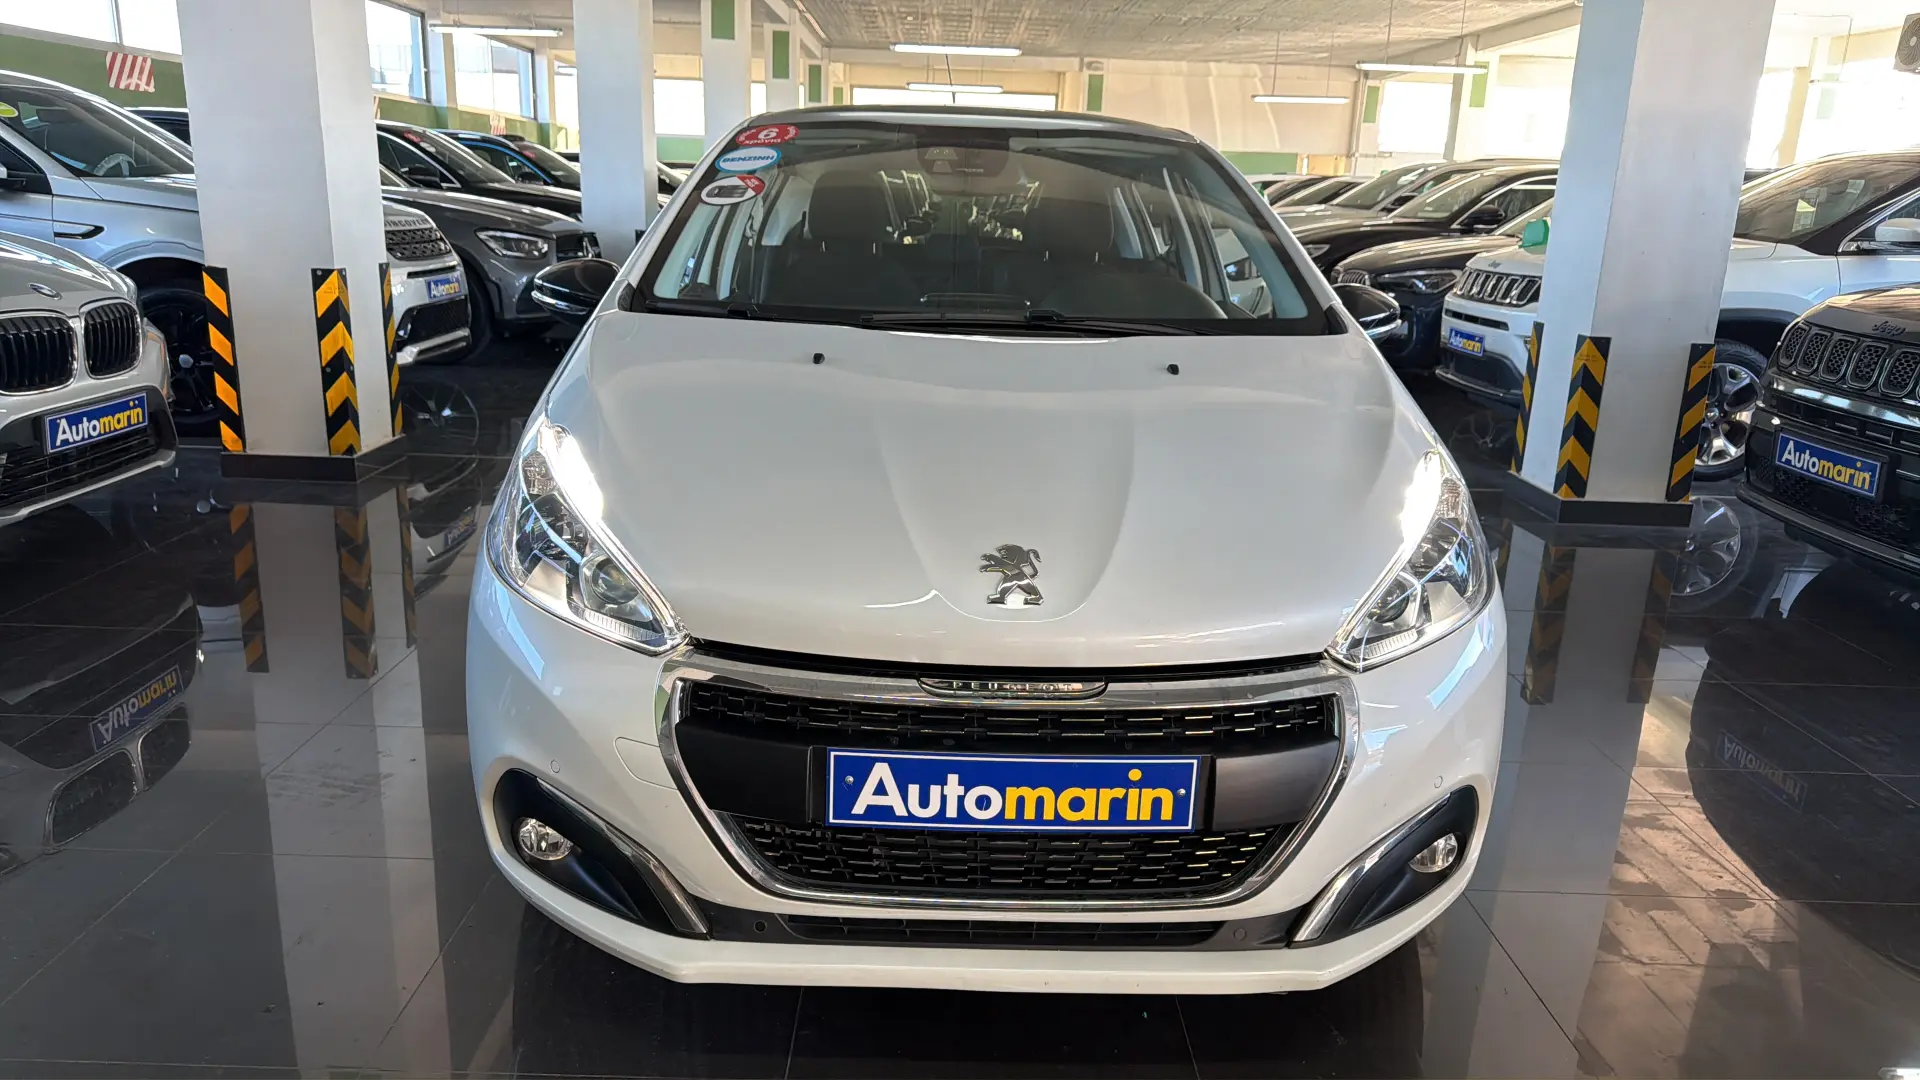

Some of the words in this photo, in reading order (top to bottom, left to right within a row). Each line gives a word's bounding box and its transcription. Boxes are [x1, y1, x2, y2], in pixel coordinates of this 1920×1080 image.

[757, 127, 779, 140] 6
[55, 400, 143, 447] Automarin
[1781, 439, 1870, 490] Automarin
[851, 761, 1174, 822] Automarin
